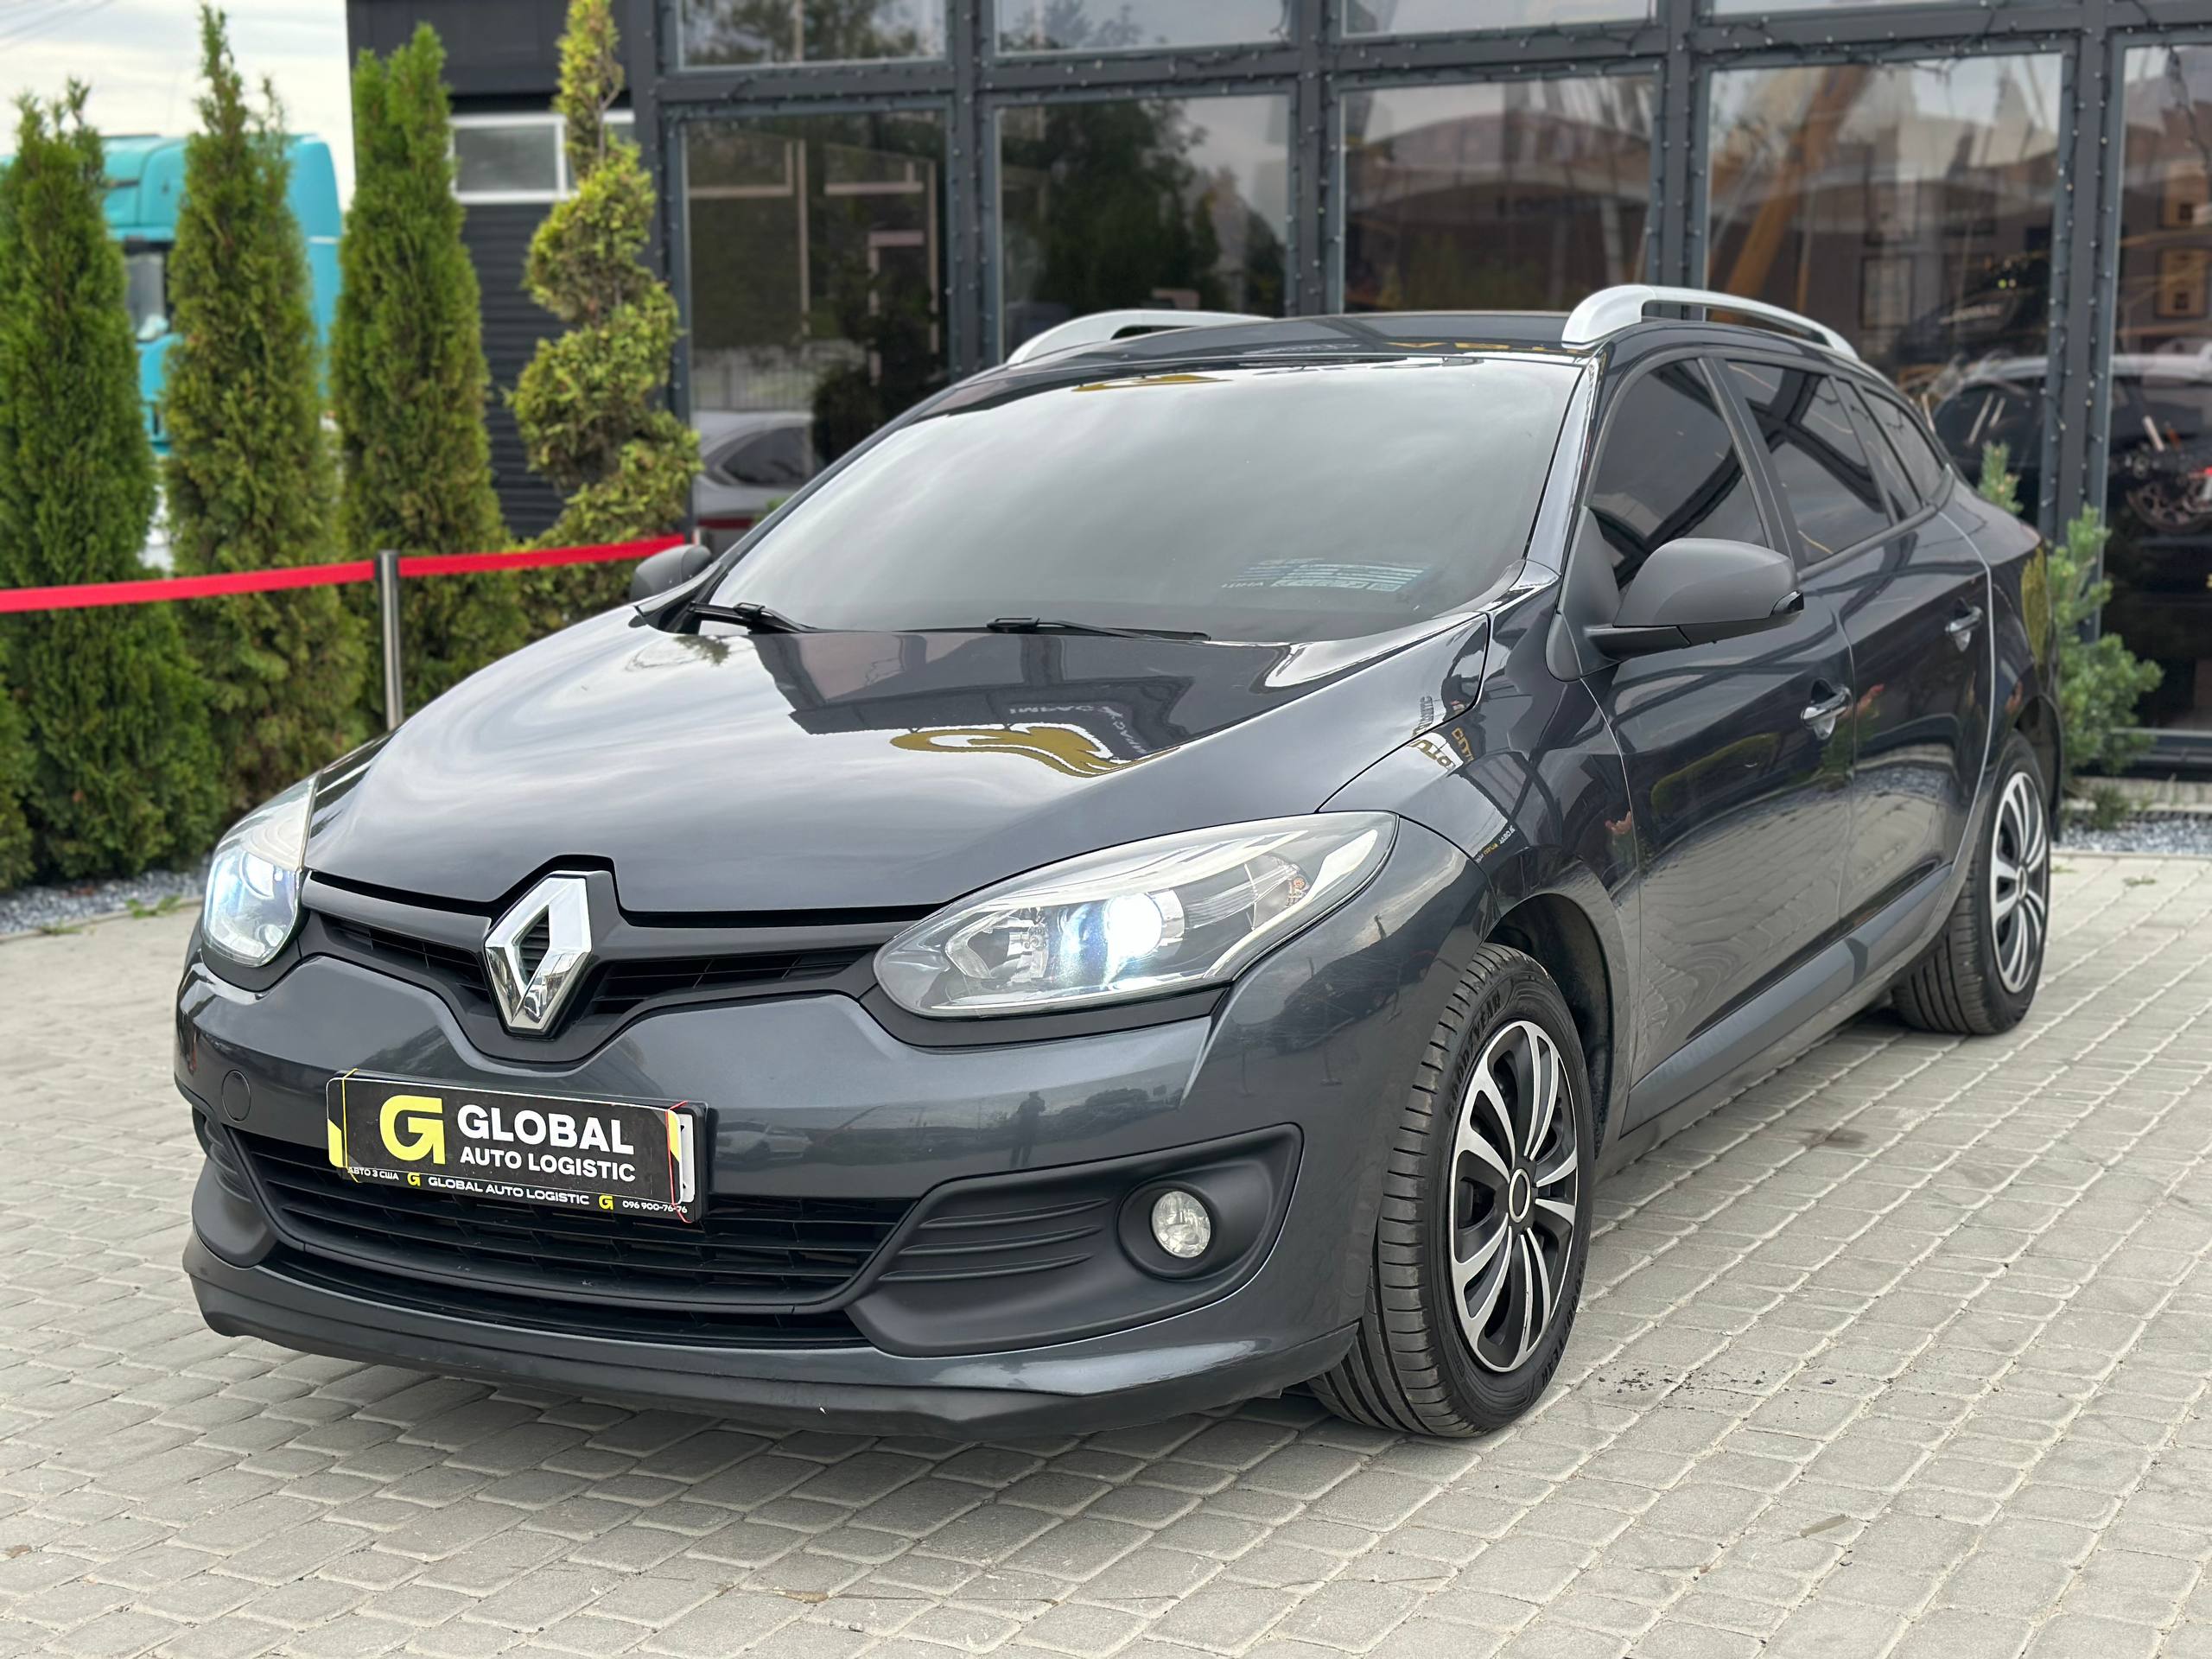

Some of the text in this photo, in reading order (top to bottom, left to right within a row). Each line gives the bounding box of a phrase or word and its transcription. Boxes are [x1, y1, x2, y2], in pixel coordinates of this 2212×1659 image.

[457, 1103, 635, 1155] GLOBAL
[378, 1171, 400, 1181] США
[460, 1146, 637, 1183] AUTO LOGISTIC
[428, 1176, 590, 1205] GLOBAL AUTO LOGISTIC
[622, 1199, 688, 1214] 096 900-76-76
